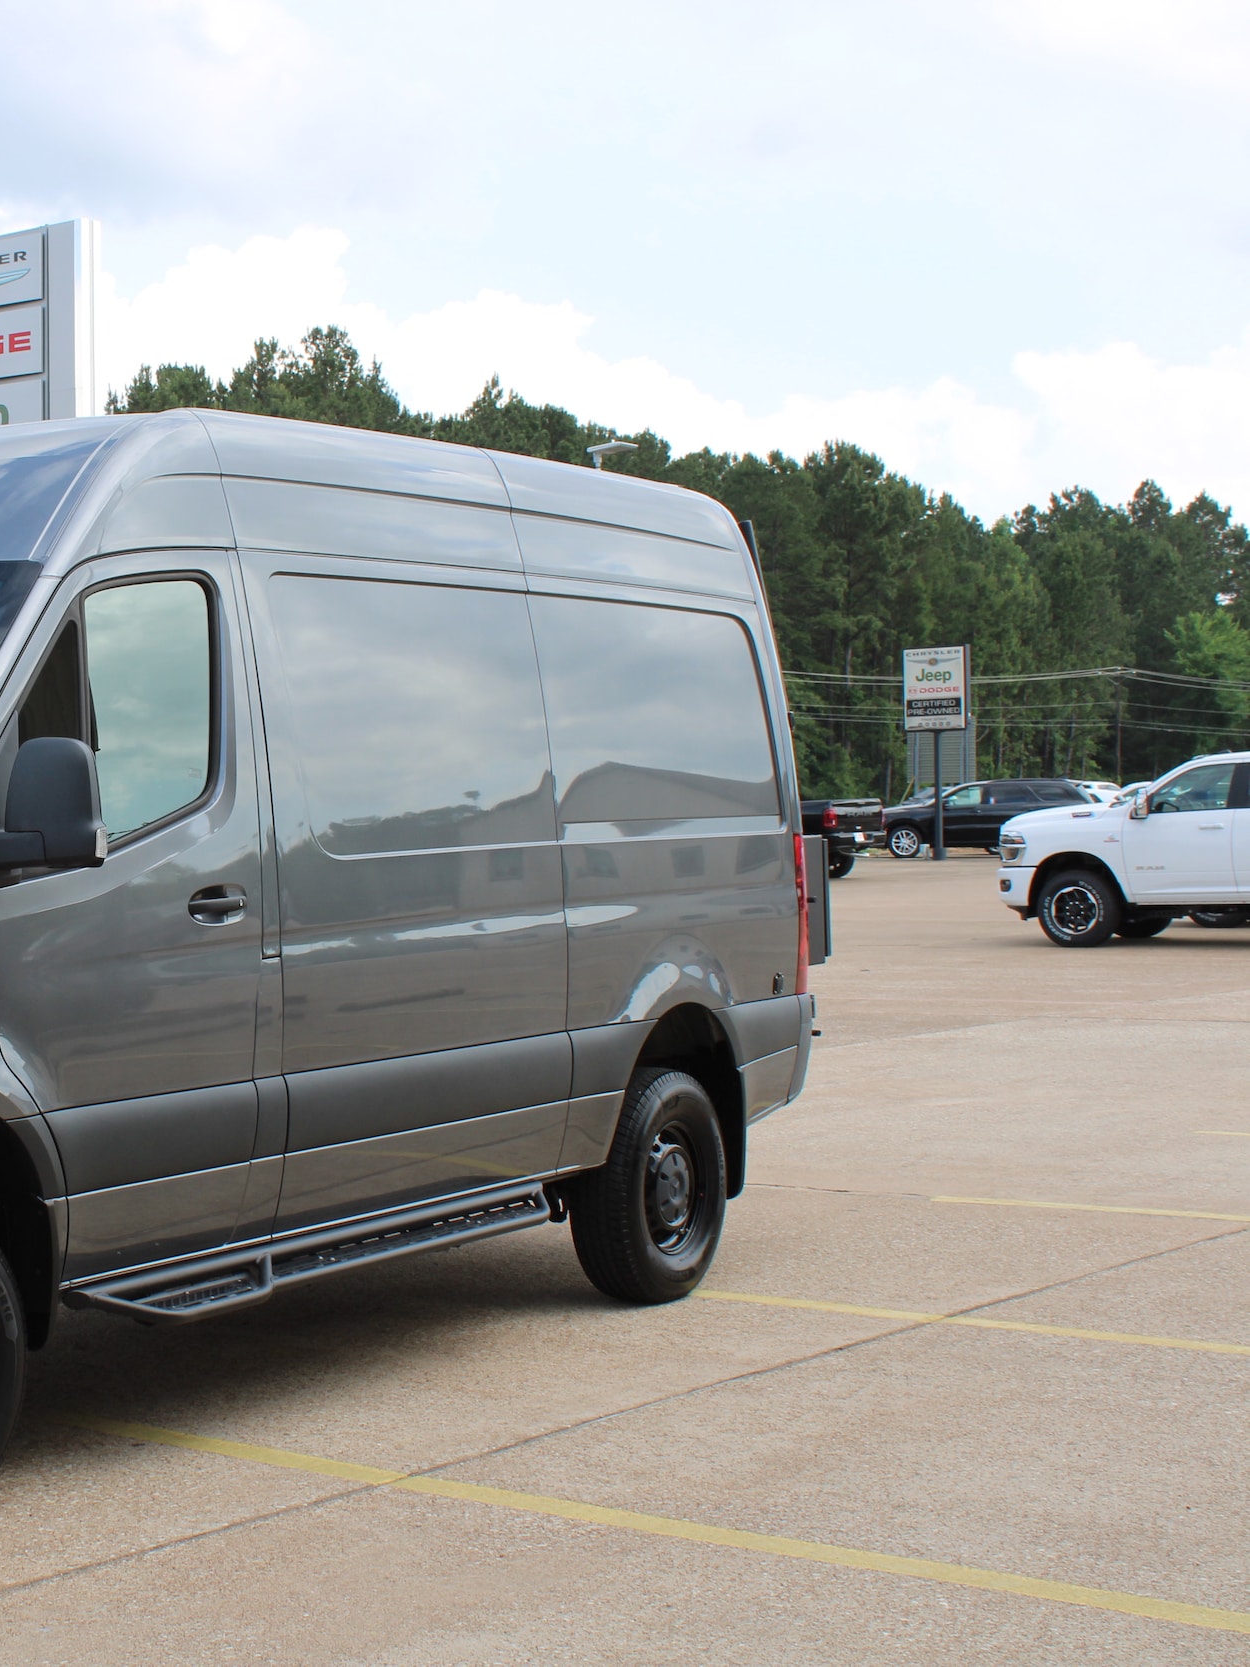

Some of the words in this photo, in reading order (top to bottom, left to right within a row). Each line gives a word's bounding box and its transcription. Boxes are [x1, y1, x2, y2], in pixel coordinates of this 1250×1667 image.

[906, 649, 960, 657] CHRYSLER
[915, 668, 952, 683] Jeep
[912, 699, 956, 708] CERTIFIED
[907, 707, 960, 715] PRE-OWNED
